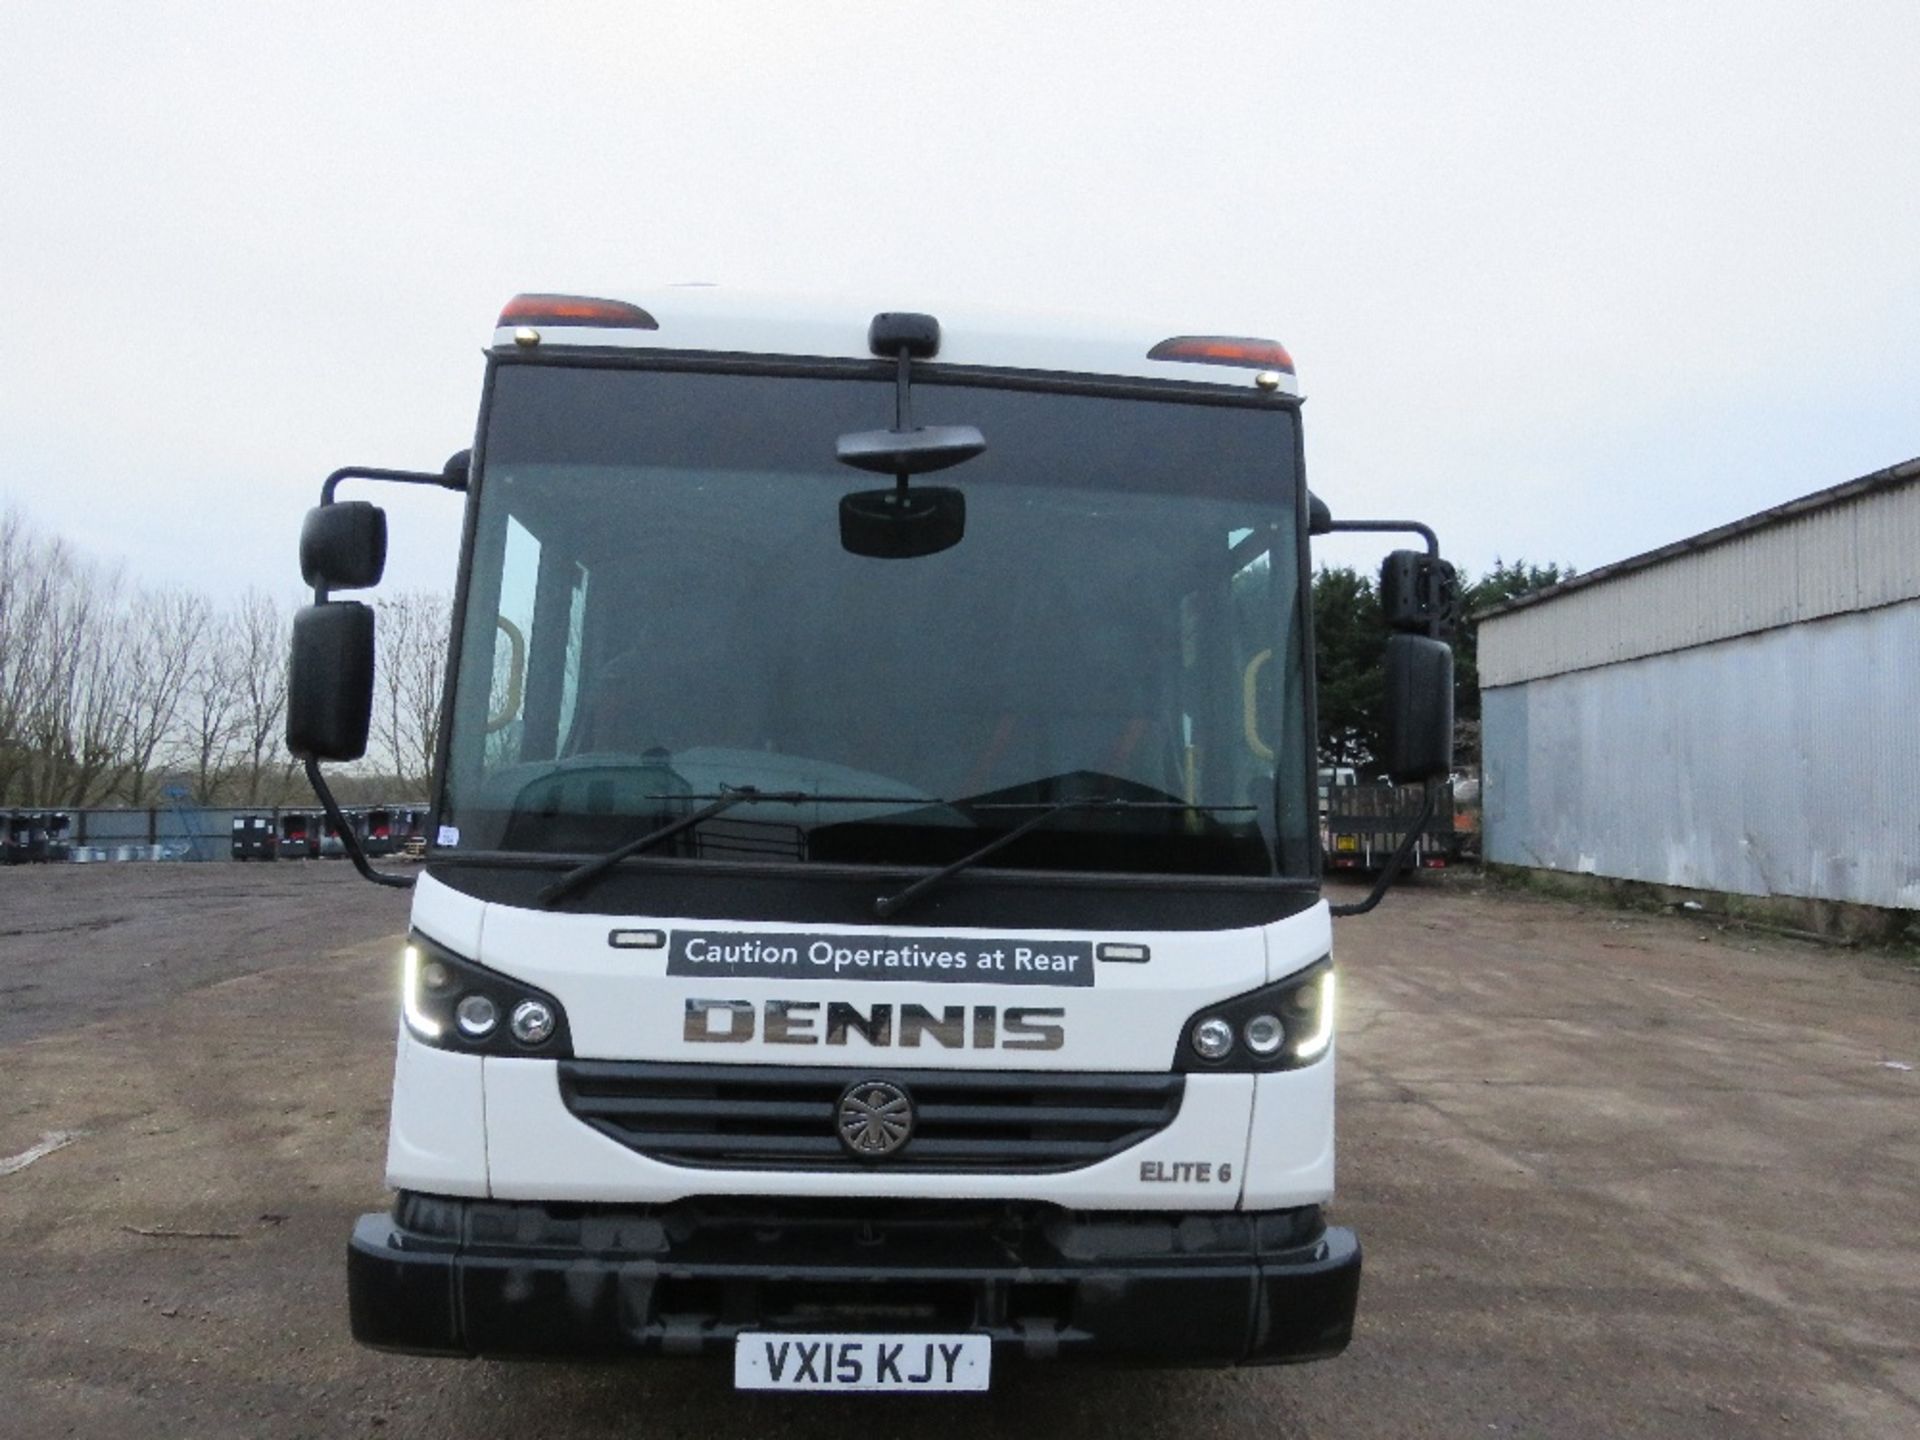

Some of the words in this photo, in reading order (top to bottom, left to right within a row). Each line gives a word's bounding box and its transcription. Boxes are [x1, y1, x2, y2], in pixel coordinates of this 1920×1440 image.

[684, 938, 798, 965] Caution
[808, 941, 967, 972] Operatives
[977, 947, 1005, 970] at
[1015, 948, 1080, 973] Rear
[684, 998, 1065, 1051] DENNIS
[1140, 1162, 1211, 1182] ELITE
[1218, 1163, 1231, 1182] 6
[765, 1341, 863, 1383] VX15
[876, 1342, 964, 1384] KJY
